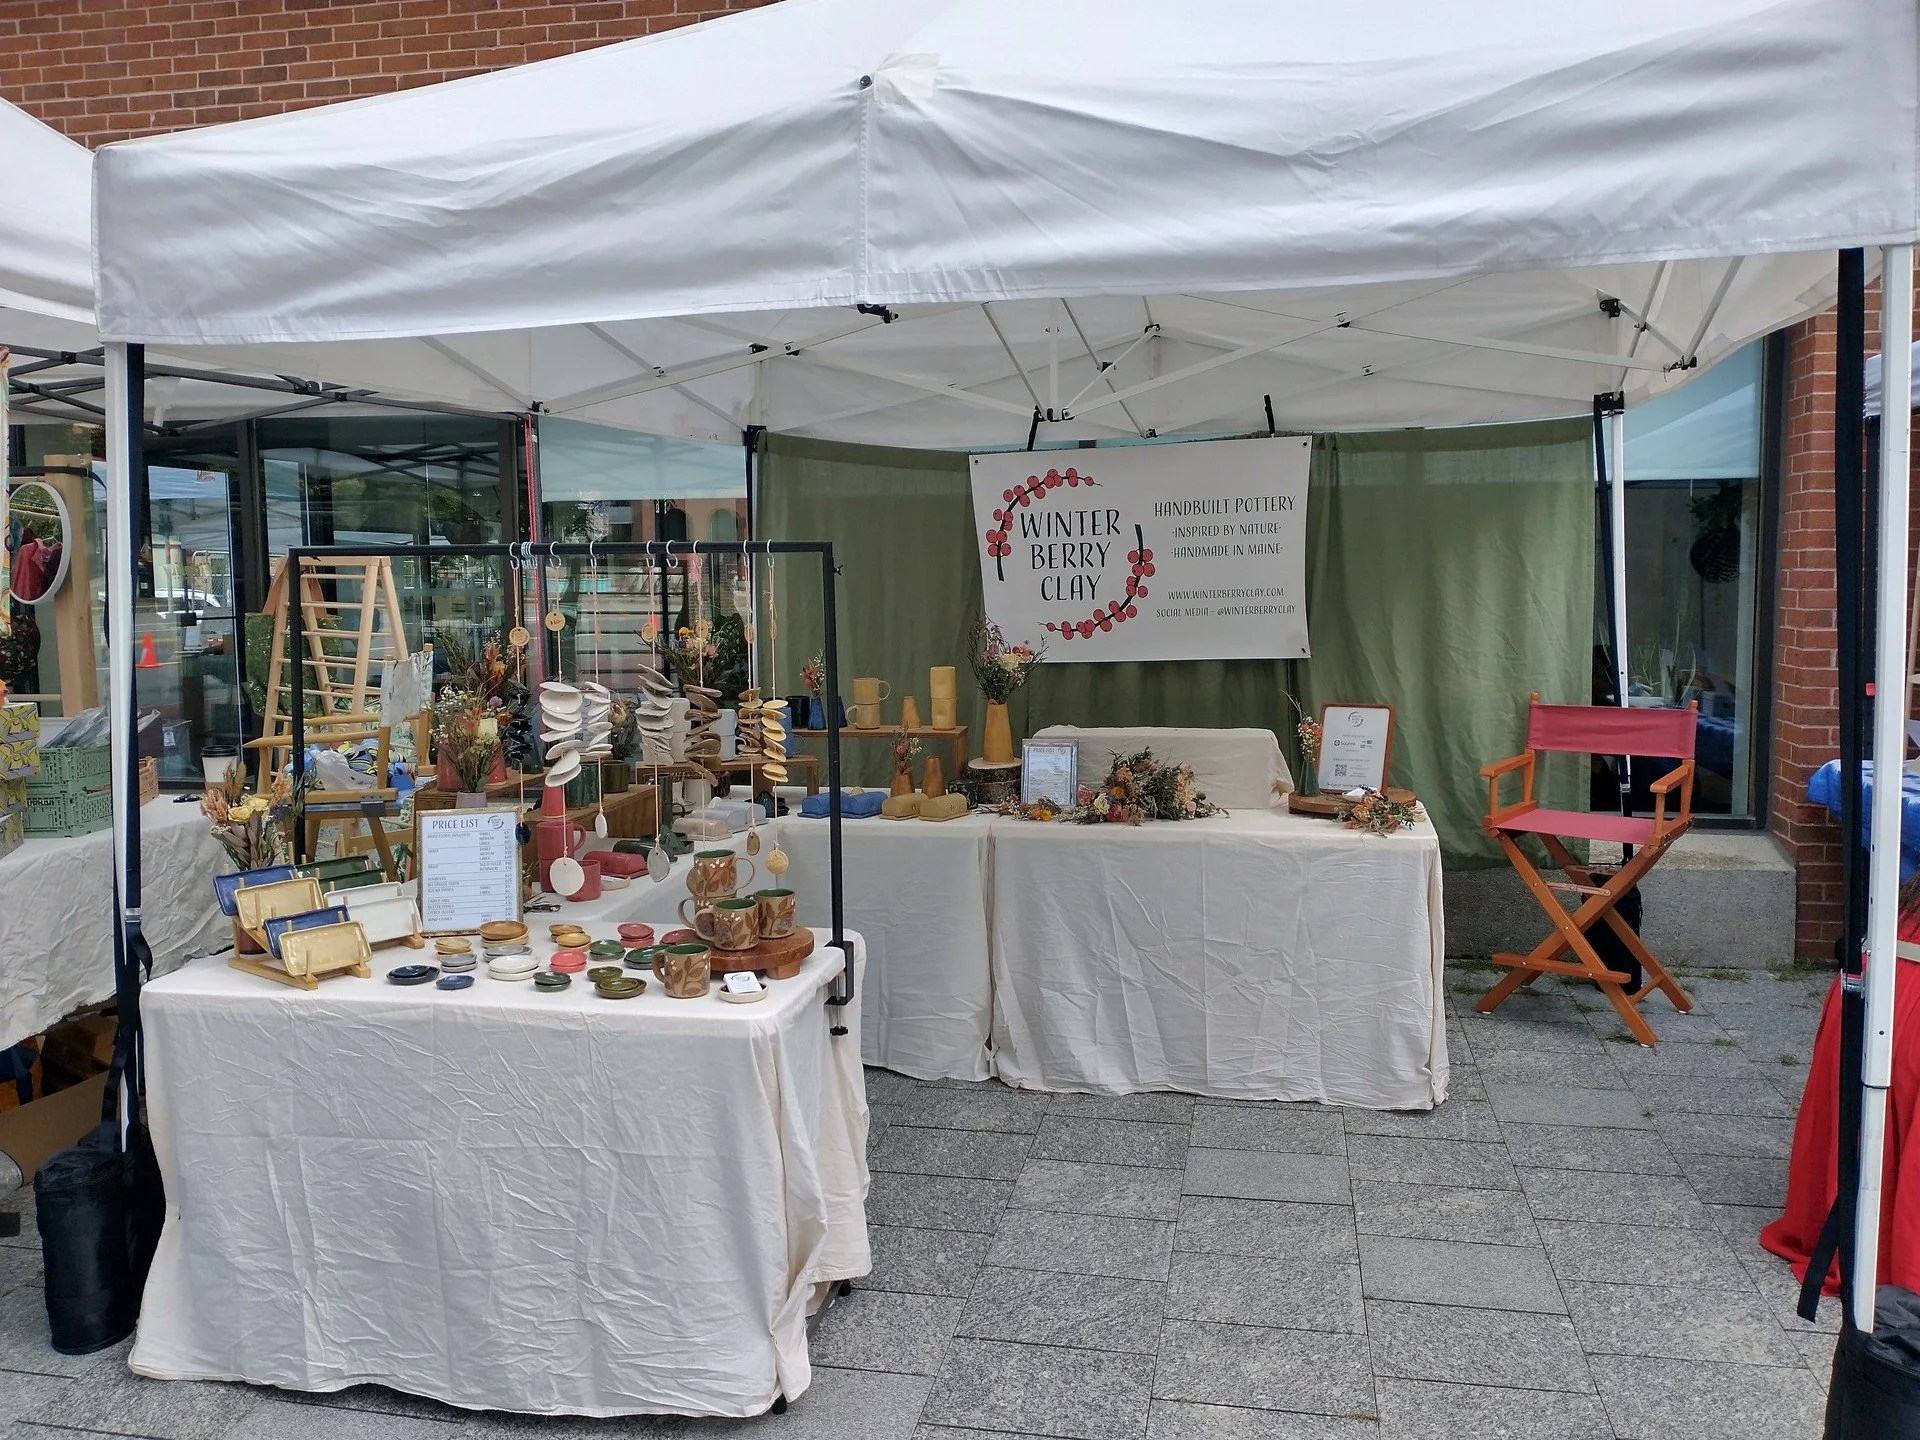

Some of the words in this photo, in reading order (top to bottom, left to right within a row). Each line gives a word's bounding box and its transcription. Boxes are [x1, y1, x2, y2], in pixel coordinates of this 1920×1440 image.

[1154, 498, 1230, 517] HANDBUILT
[1235, 495, 1296, 513] POTTERY
[1020, 508, 1121, 540] WINTER
[1223, 524, 1237, 536] BY
[1030, 541, 1112, 570] BERRY
[1233, 544, 1244, 556] IN
[1040, 573, 1102, 602] CLAY
[1168, 587, 1284, 600] WWW.WINTERBERRYCLAY.COM
[1156, 607, 1182, 618] SOCIAL
[1184, 607, 1209, 617] MEDIA
[1217, 604, 1296, 616] @WINTERBERRYCLAY
[432, 819, 458, 829] PRICE
[460, 818, 479, 829] LIST
